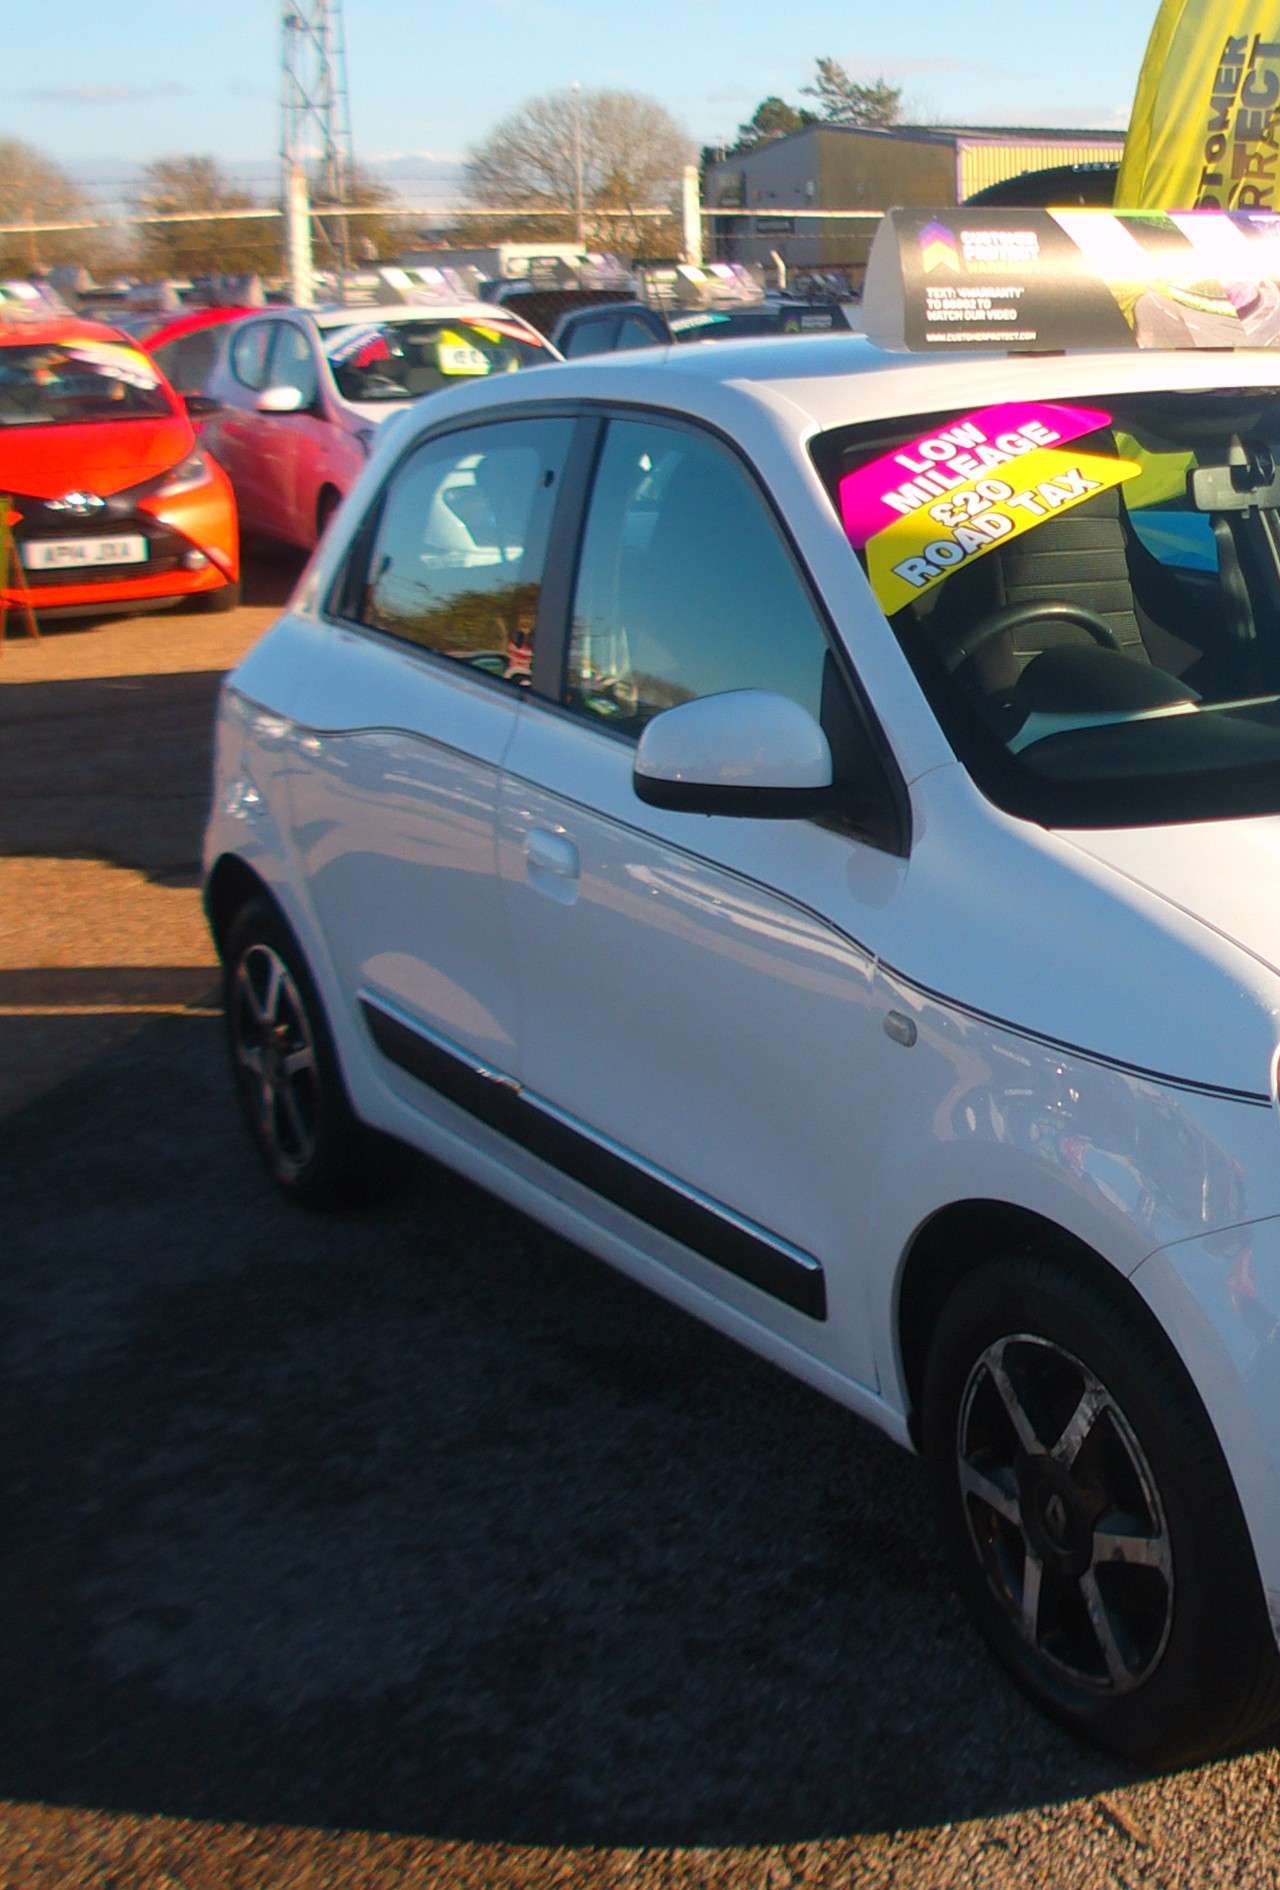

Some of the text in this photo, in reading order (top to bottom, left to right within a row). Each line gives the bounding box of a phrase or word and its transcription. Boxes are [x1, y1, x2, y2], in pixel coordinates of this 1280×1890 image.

[926, 309, 1017, 321] WATCH OUR VIDEO
[880, 420, 1061, 515] MILEAGE
[894, 421, 989, 475] LOW
[891, 467, 1104, 589] ROAD TAX
[928, 479, 1015, 529] £20
